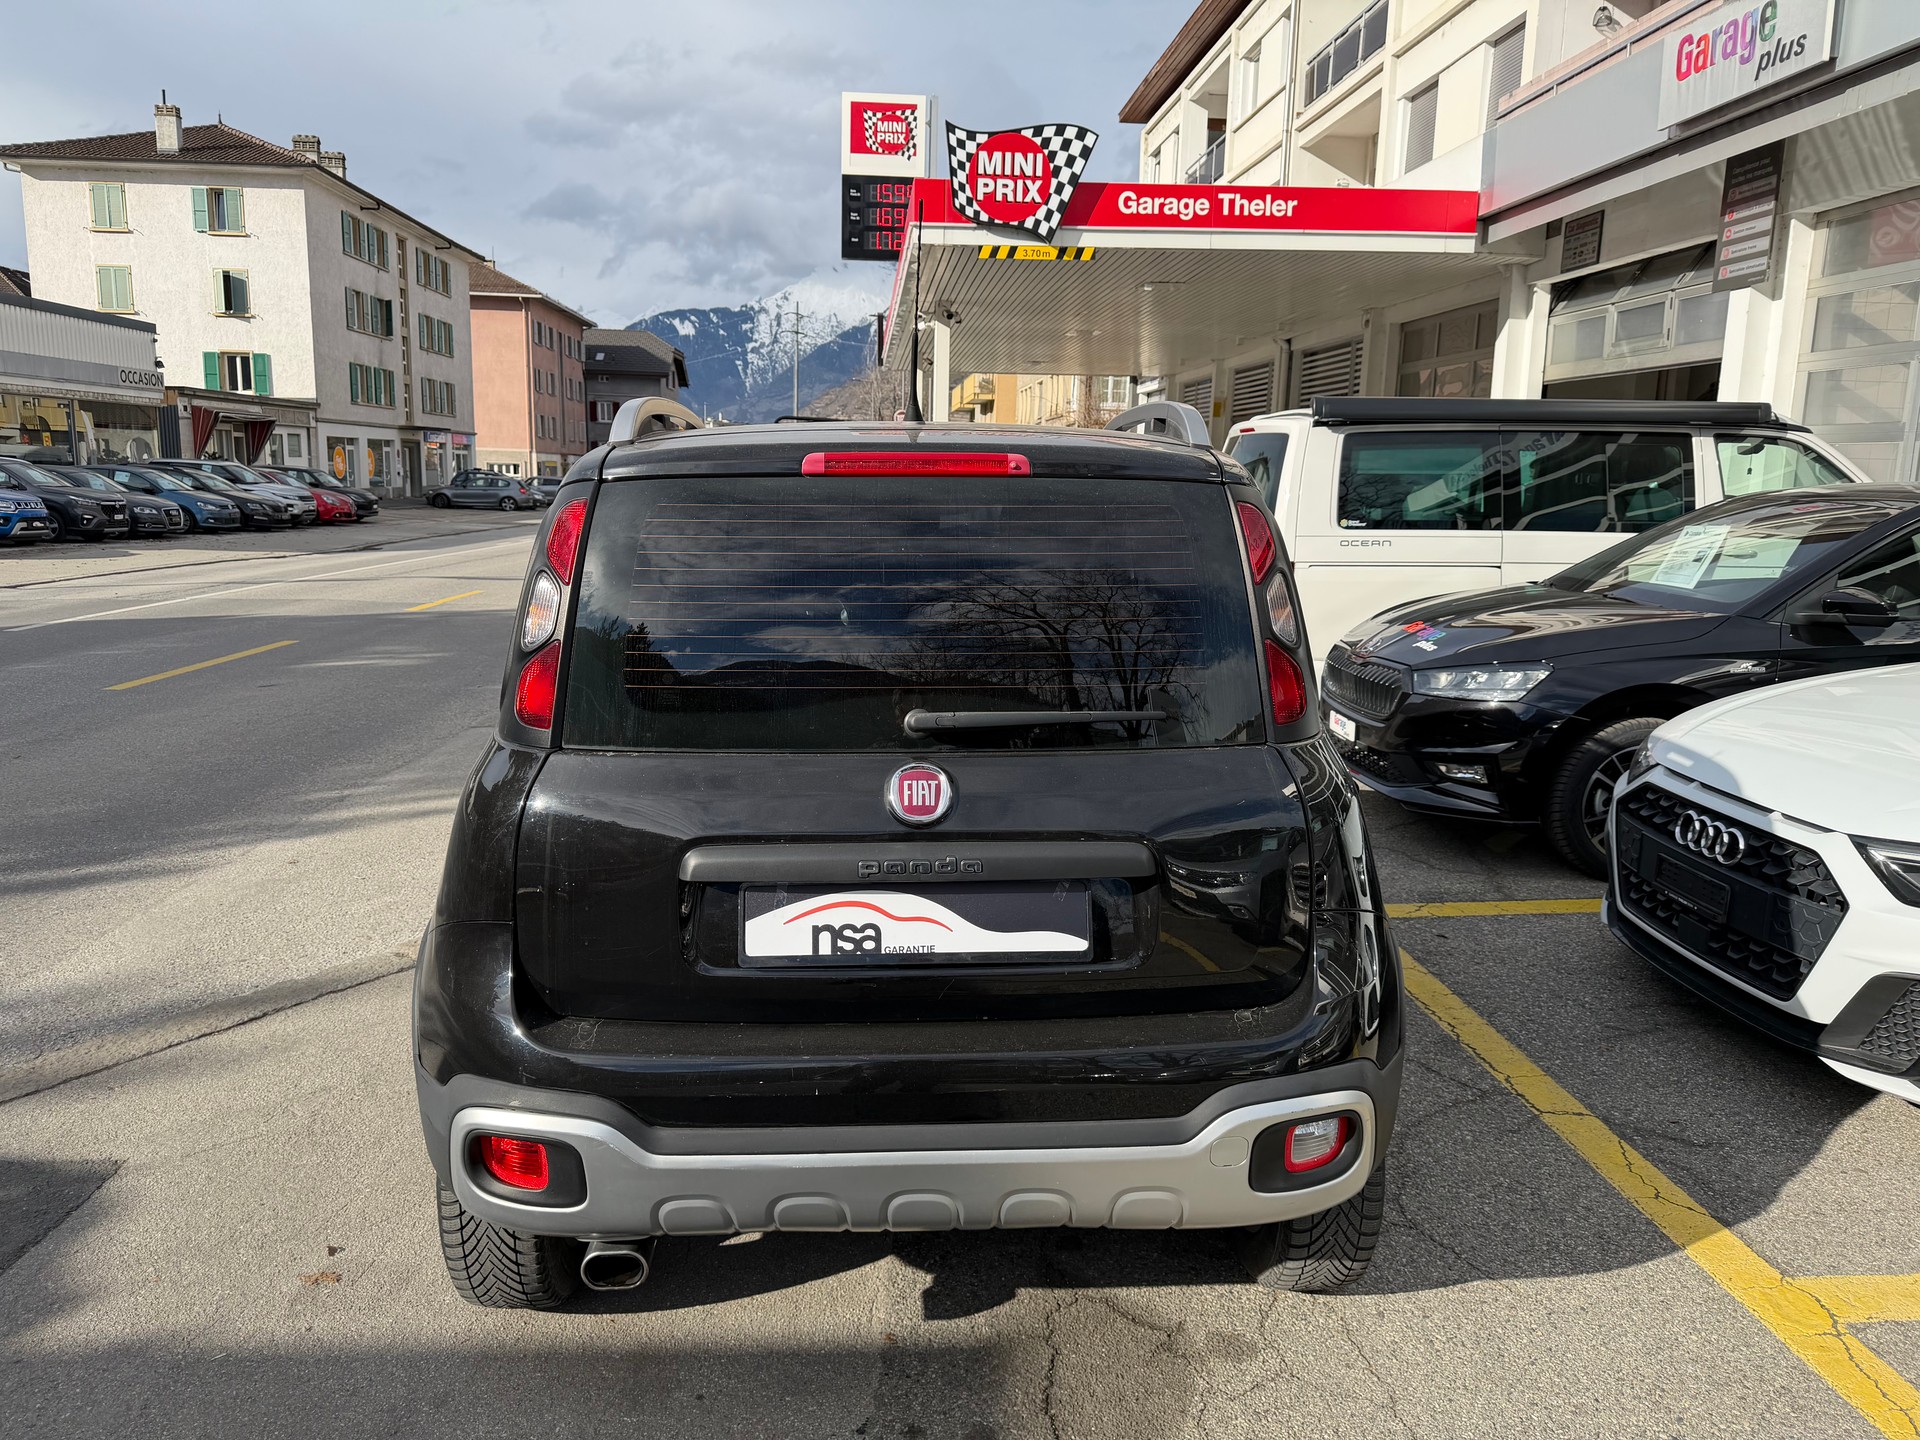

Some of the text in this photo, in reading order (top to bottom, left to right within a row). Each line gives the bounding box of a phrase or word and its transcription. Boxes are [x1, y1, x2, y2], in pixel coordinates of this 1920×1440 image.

[1676, 0, 1778, 81] Garage
[1754, 33, 1808, 81] plus
[877, 121, 906, 132] MINI
[877, 132, 907, 144] PRIX
[977, 151, 1043, 177] MINI
[976, 177, 1042, 204] PRIX
[1118, 190, 1297, 221] Garage Theler
[1022, 249, 1041, 258] 3.70
[120, 369, 164, 388] OCCASION
[1340, 539, 1392, 547] OCEAN
[903, 780, 939, 806] FIAT
[857, 855, 983, 878] panda
[811, 922, 882, 955] nsa
[884, 945, 936, 954] GARANTIE
